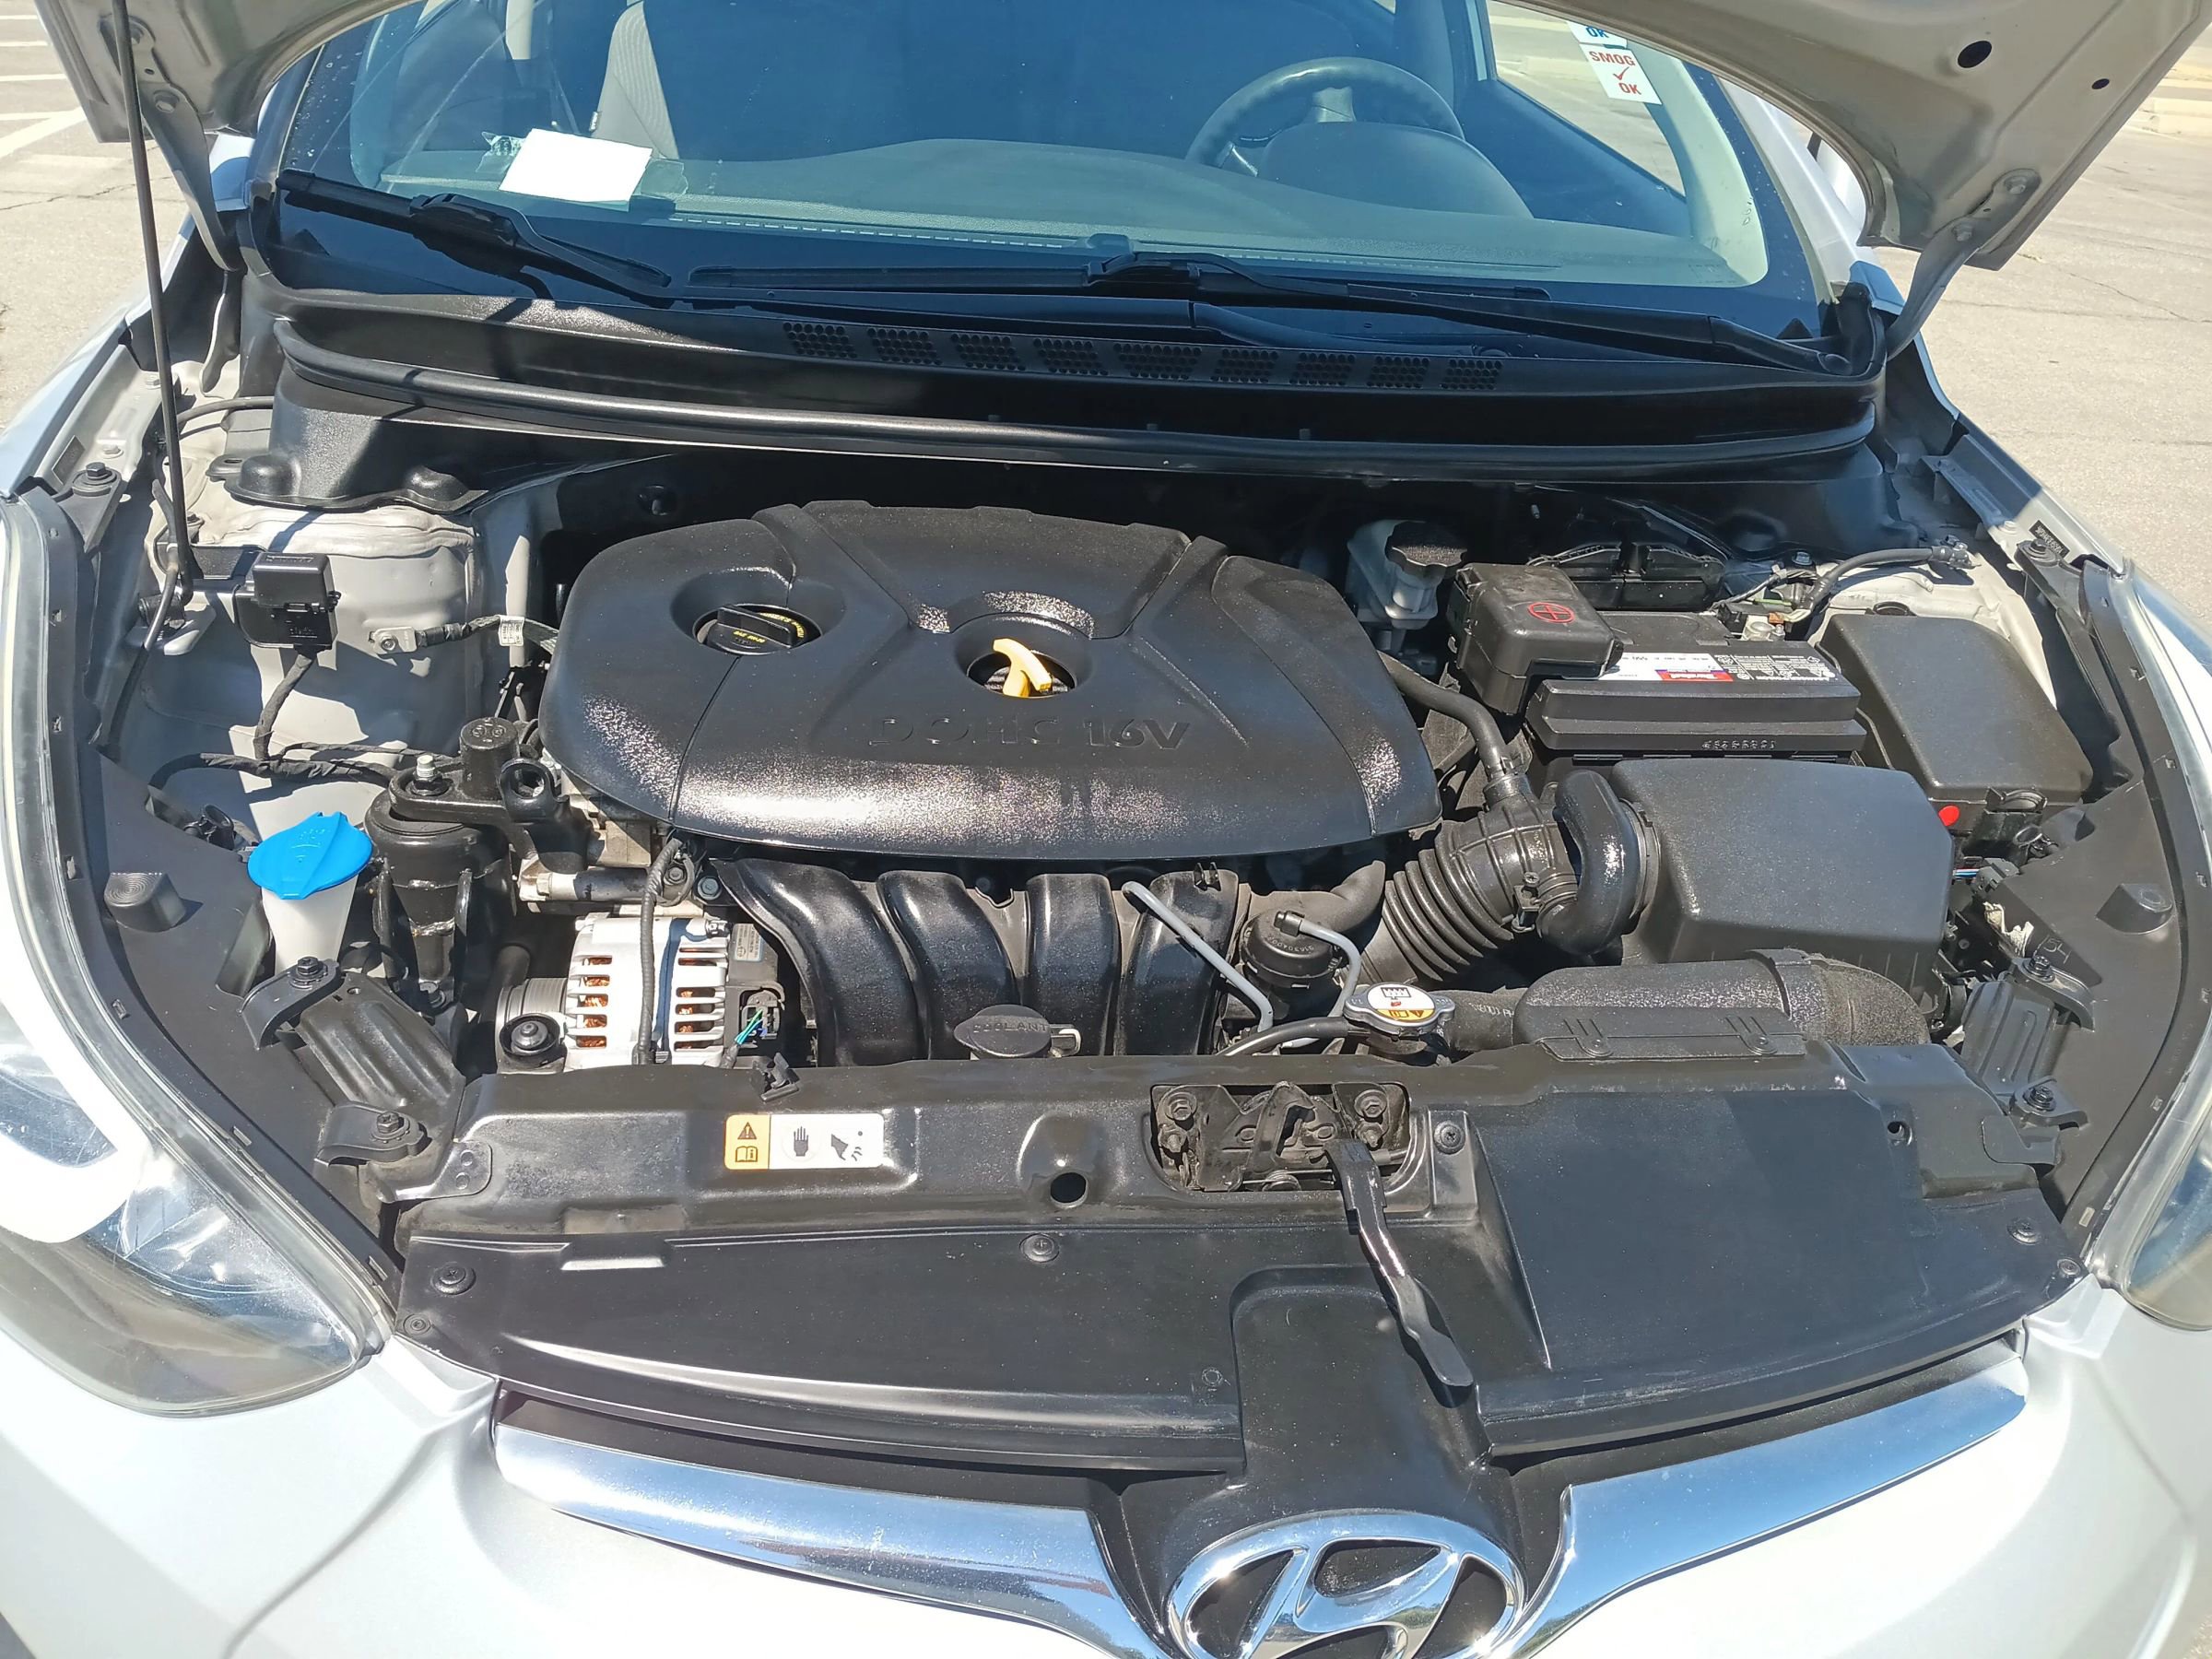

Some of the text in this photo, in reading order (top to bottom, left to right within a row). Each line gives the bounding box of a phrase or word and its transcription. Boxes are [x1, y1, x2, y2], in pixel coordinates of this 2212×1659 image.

[1588, 51, 1636, 66] SMOG
[1618, 82, 1641, 95] OK
[1082, 717, 1191, 749] 16V
[972, 1022, 1048, 1033] COOLANT
